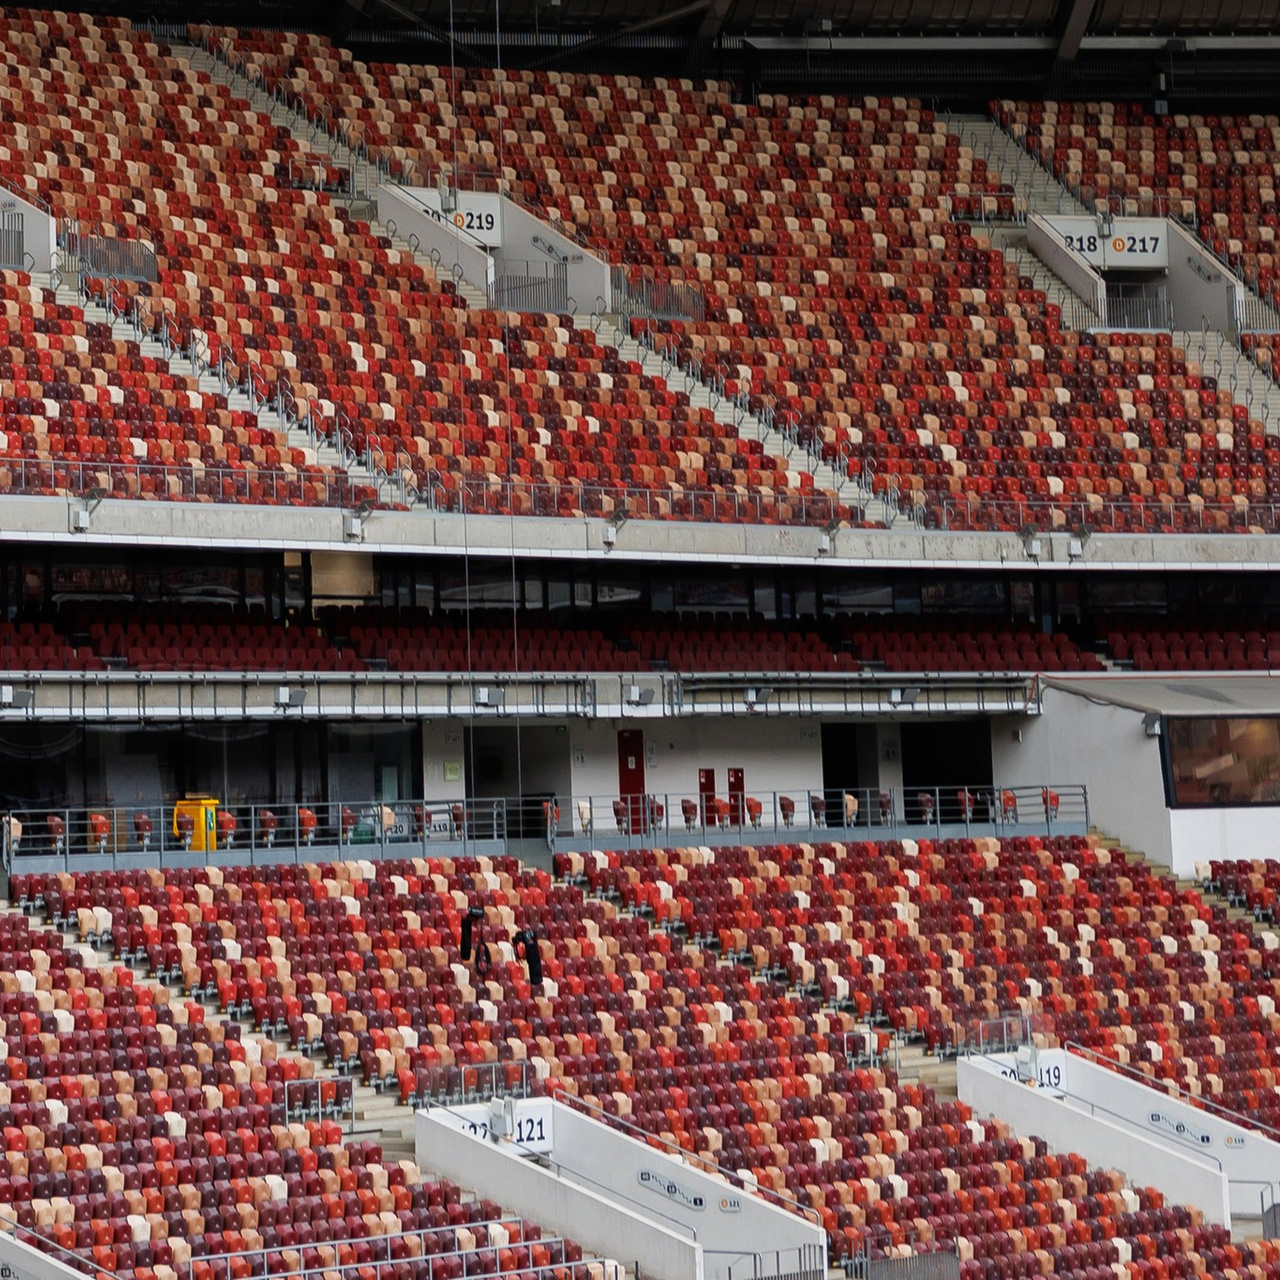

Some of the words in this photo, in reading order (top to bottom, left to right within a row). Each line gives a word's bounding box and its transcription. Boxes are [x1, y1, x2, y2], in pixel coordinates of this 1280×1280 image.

[466, 212, 494, 230] 219
[1127, 236, 1159, 253] 217
[516, 1117, 545, 1142] 121
